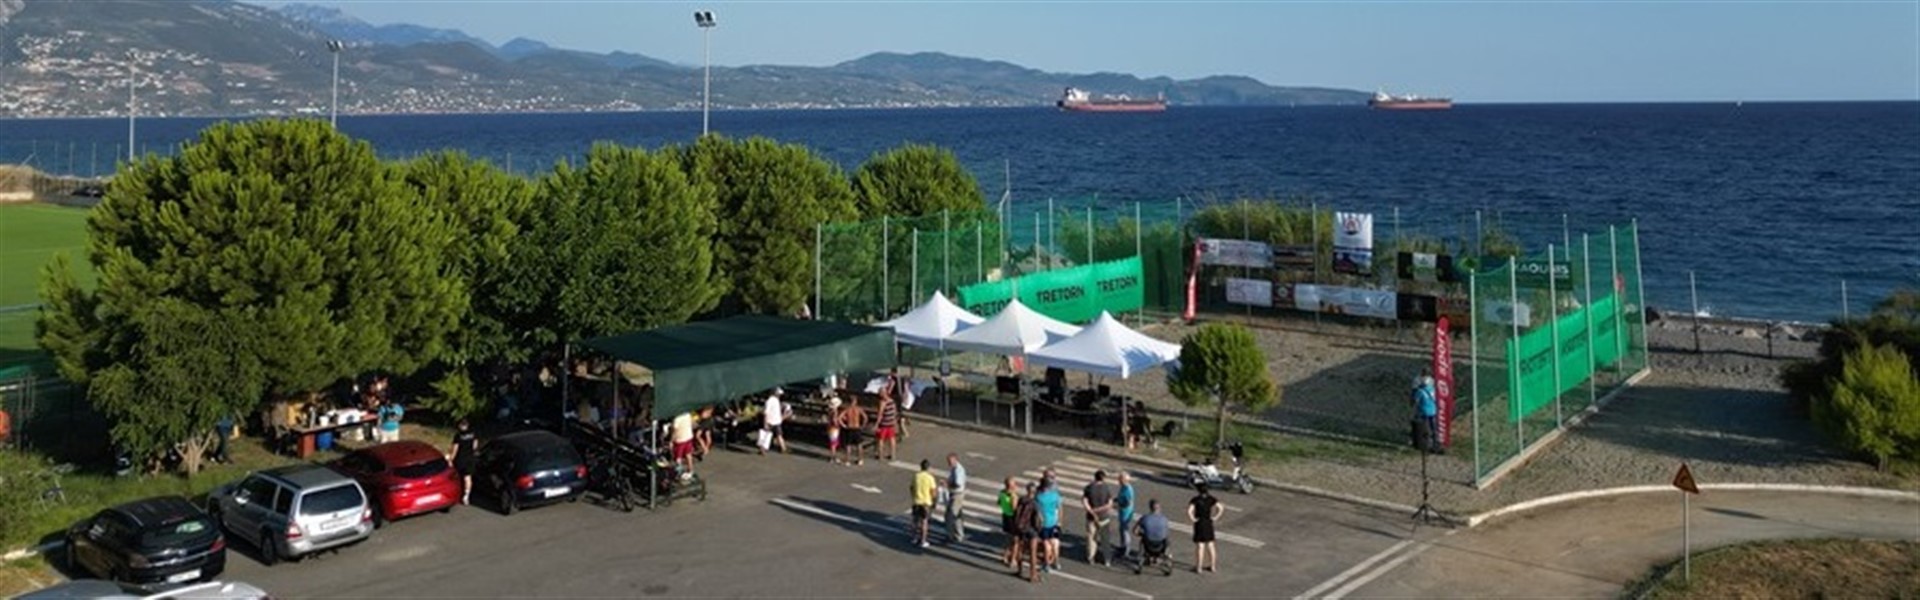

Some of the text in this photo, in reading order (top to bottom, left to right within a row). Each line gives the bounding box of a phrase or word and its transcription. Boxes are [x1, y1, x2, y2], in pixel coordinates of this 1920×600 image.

[1097, 276, 1138, 292] TRETORN
[1036, 286, 1085, 304] TRETORN
[1436, 327, 1449, 376] sport
